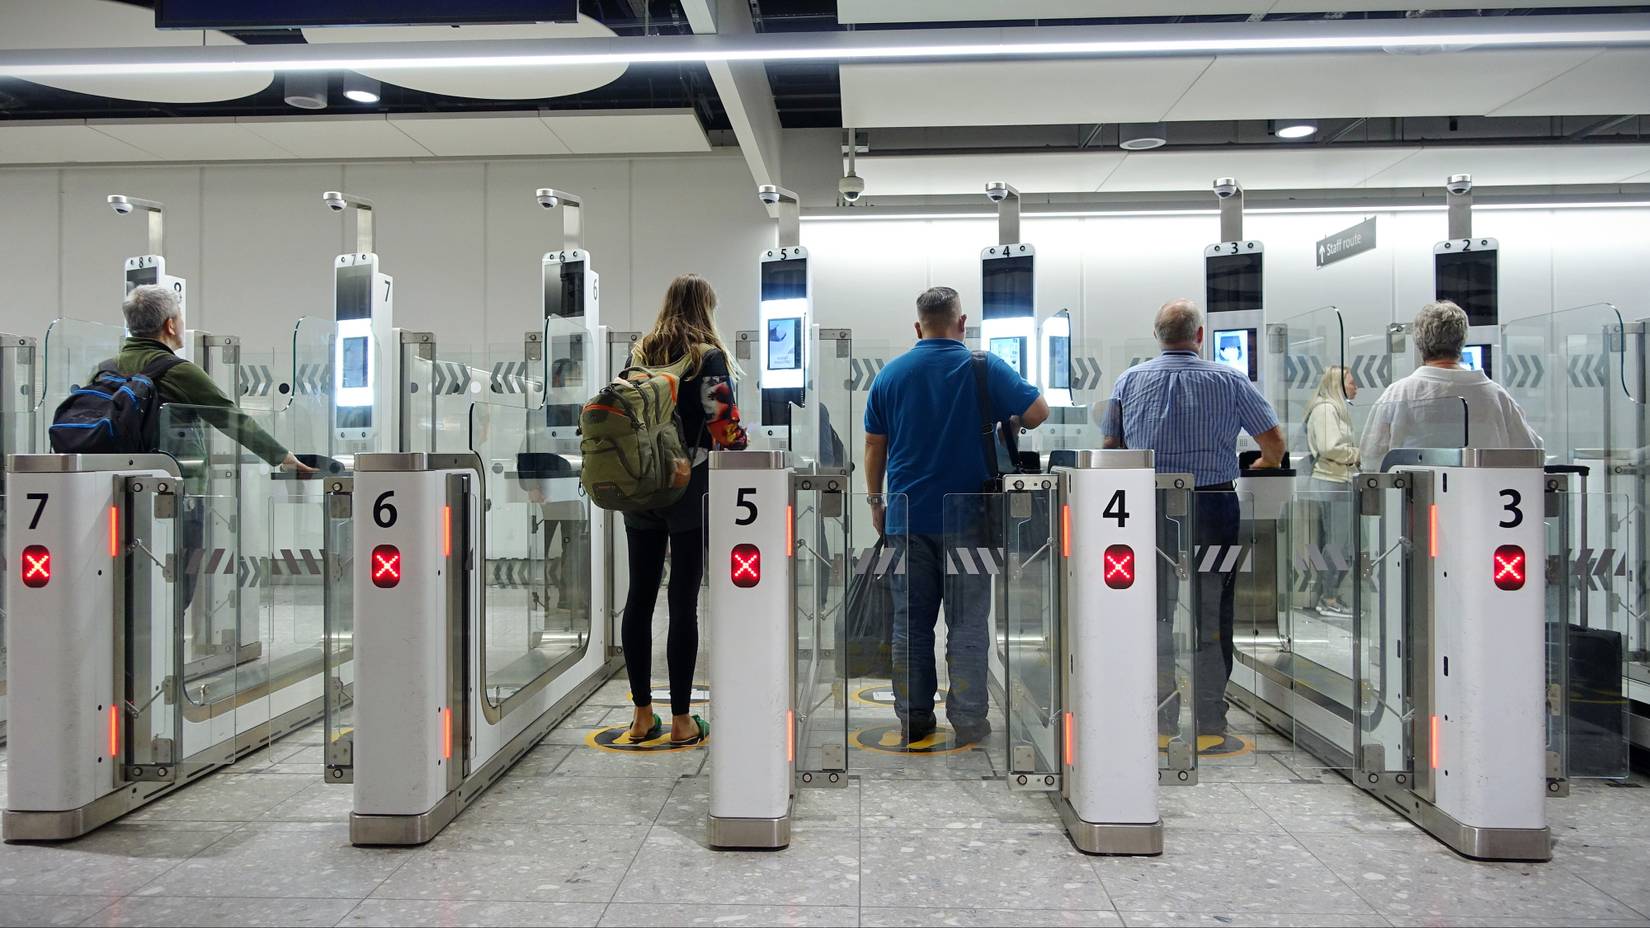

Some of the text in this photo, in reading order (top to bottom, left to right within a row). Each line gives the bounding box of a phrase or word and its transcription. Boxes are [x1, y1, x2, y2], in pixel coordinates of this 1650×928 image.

[1002, 246, 1011, 257] 4
[1230, 243, 1238, 254] 3
[1327, 231, 1361, 256] Staff route
[1462, 239, 1471, 251] 2
[138, 257, 144, 268] 8
[351, 254, 357, 266] 7
[559, 251, 566, 264] 6
[780, 249, 787, 261] 5
[384, 280, 391, 302] 7
[593, 279, 598, 301] 6
[27, 493, 48, 529] 7
[373, 491, 397, 528] 6
[735, 488, 757, 525] 5
[1103, 490, 1129, 527] 4
[1499, 489, 1523, 528] 3
